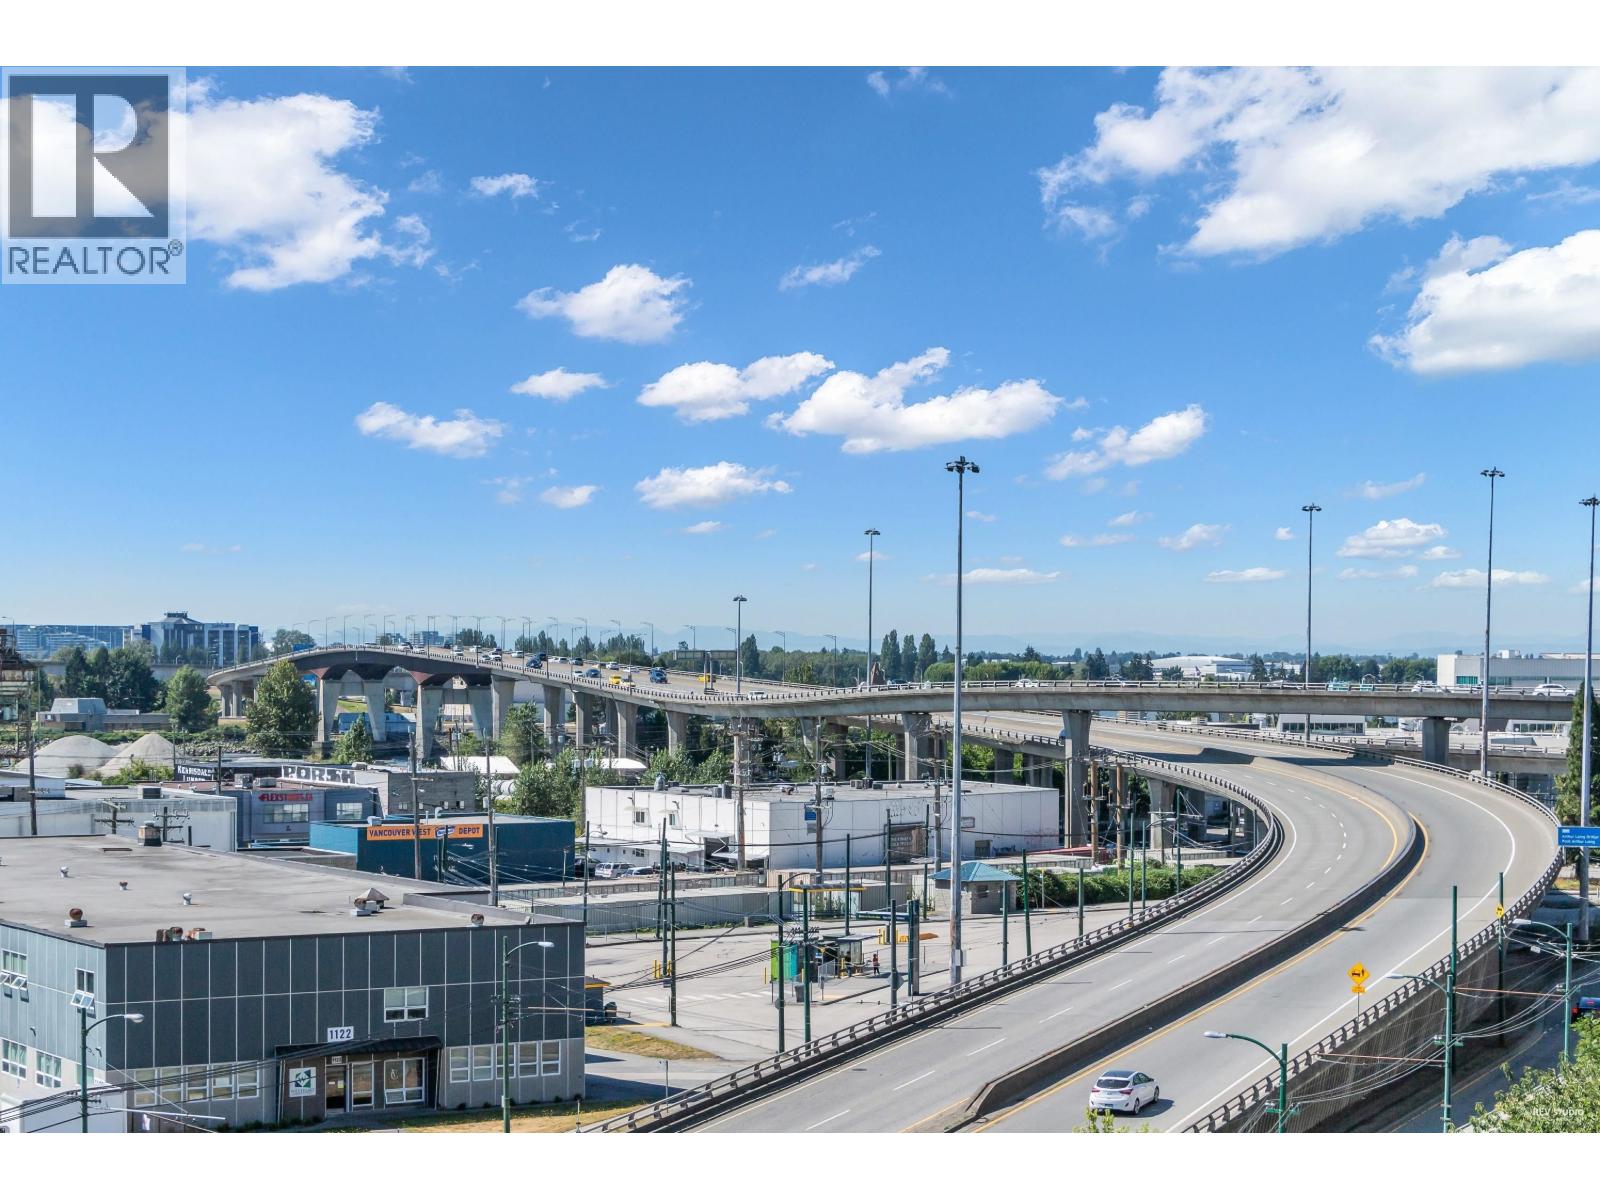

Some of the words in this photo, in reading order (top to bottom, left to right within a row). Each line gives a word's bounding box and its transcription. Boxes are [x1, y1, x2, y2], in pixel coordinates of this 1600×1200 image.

[369, 828, 411, 837] VANCOUVER
[458, 827, 480, 835] DEPOT
[330, 1029, 351, 1039] 1122
